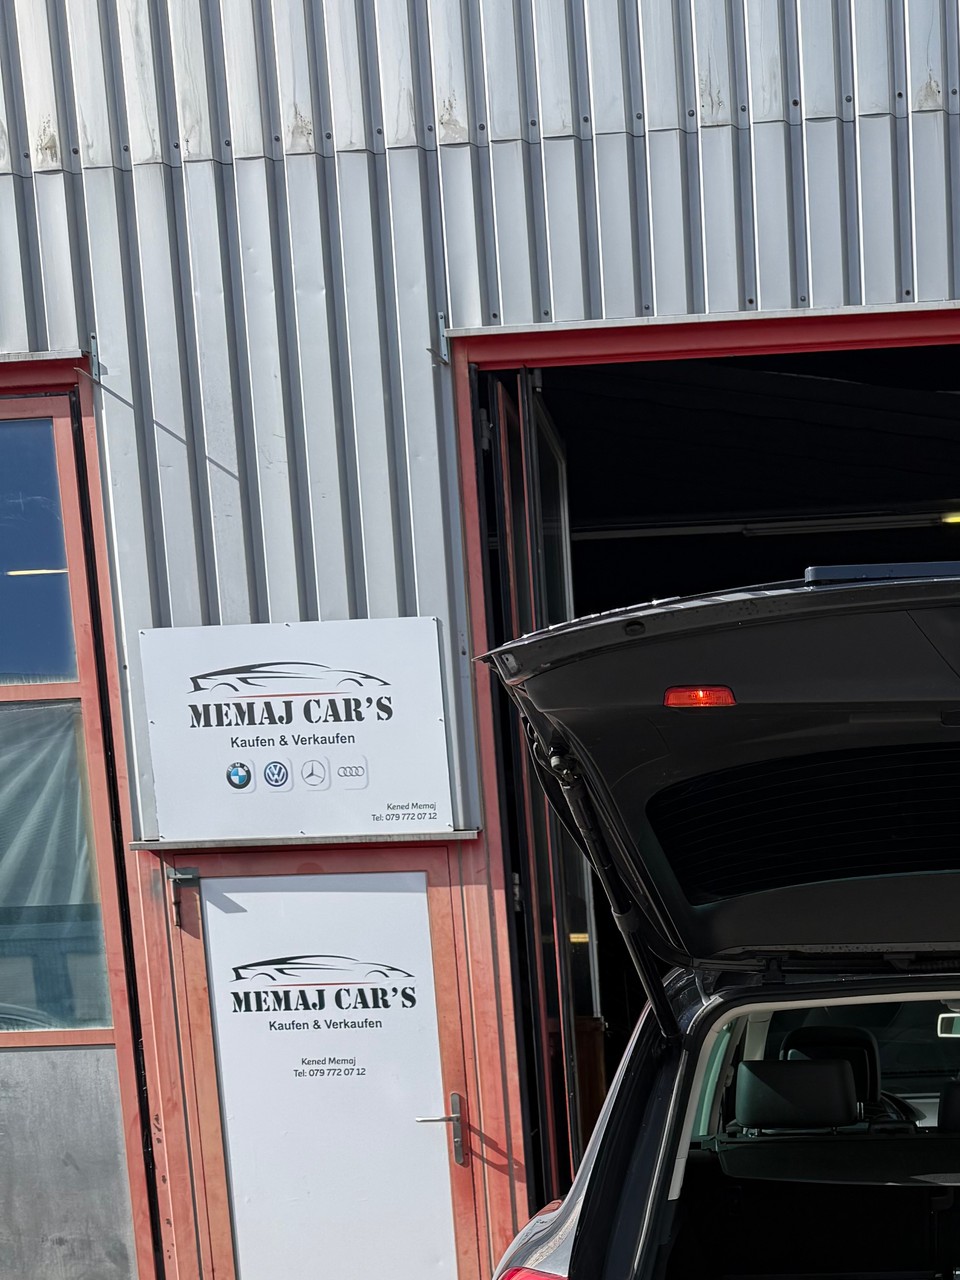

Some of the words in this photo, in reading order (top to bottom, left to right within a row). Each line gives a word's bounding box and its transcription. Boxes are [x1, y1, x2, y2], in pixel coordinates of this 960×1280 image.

[188, 701, 293, 728] MEMAJ
[303, 696, 393, 724] CAR'S
[230, 736, 275, 748] Kaufen
[279, 735, 289, 746] &
[291, 733, 356, 746] Verkaufen
[386, 803, 409, 811] Kened
[411, 802, 437, 811] Memaj
[385, 813, 400, 821] 079
[416, 812, 427, 820] 07
[428, 812, 437, 820] 12
[231, 988, 326, 1013] MEMAJ
[334, 986, 417, 1010] CAR'S
[269, 1020, 309, 1031] Kaufen
[313, 1019, 321, 1030] &
[324, 1018, 382, 1030] Verkaufen
[301, 1057, 326, 1065] Kened
[328, 1057, 356, 1066] Memaj
[293, 1069, 307, 1077] Tel:
[308, 1069, 325, 1077] 079
[327, 1068, 342, 1076] 772
[343, 1068, 354, 1076] 07
[356, 1068, 366, 1076] 12
